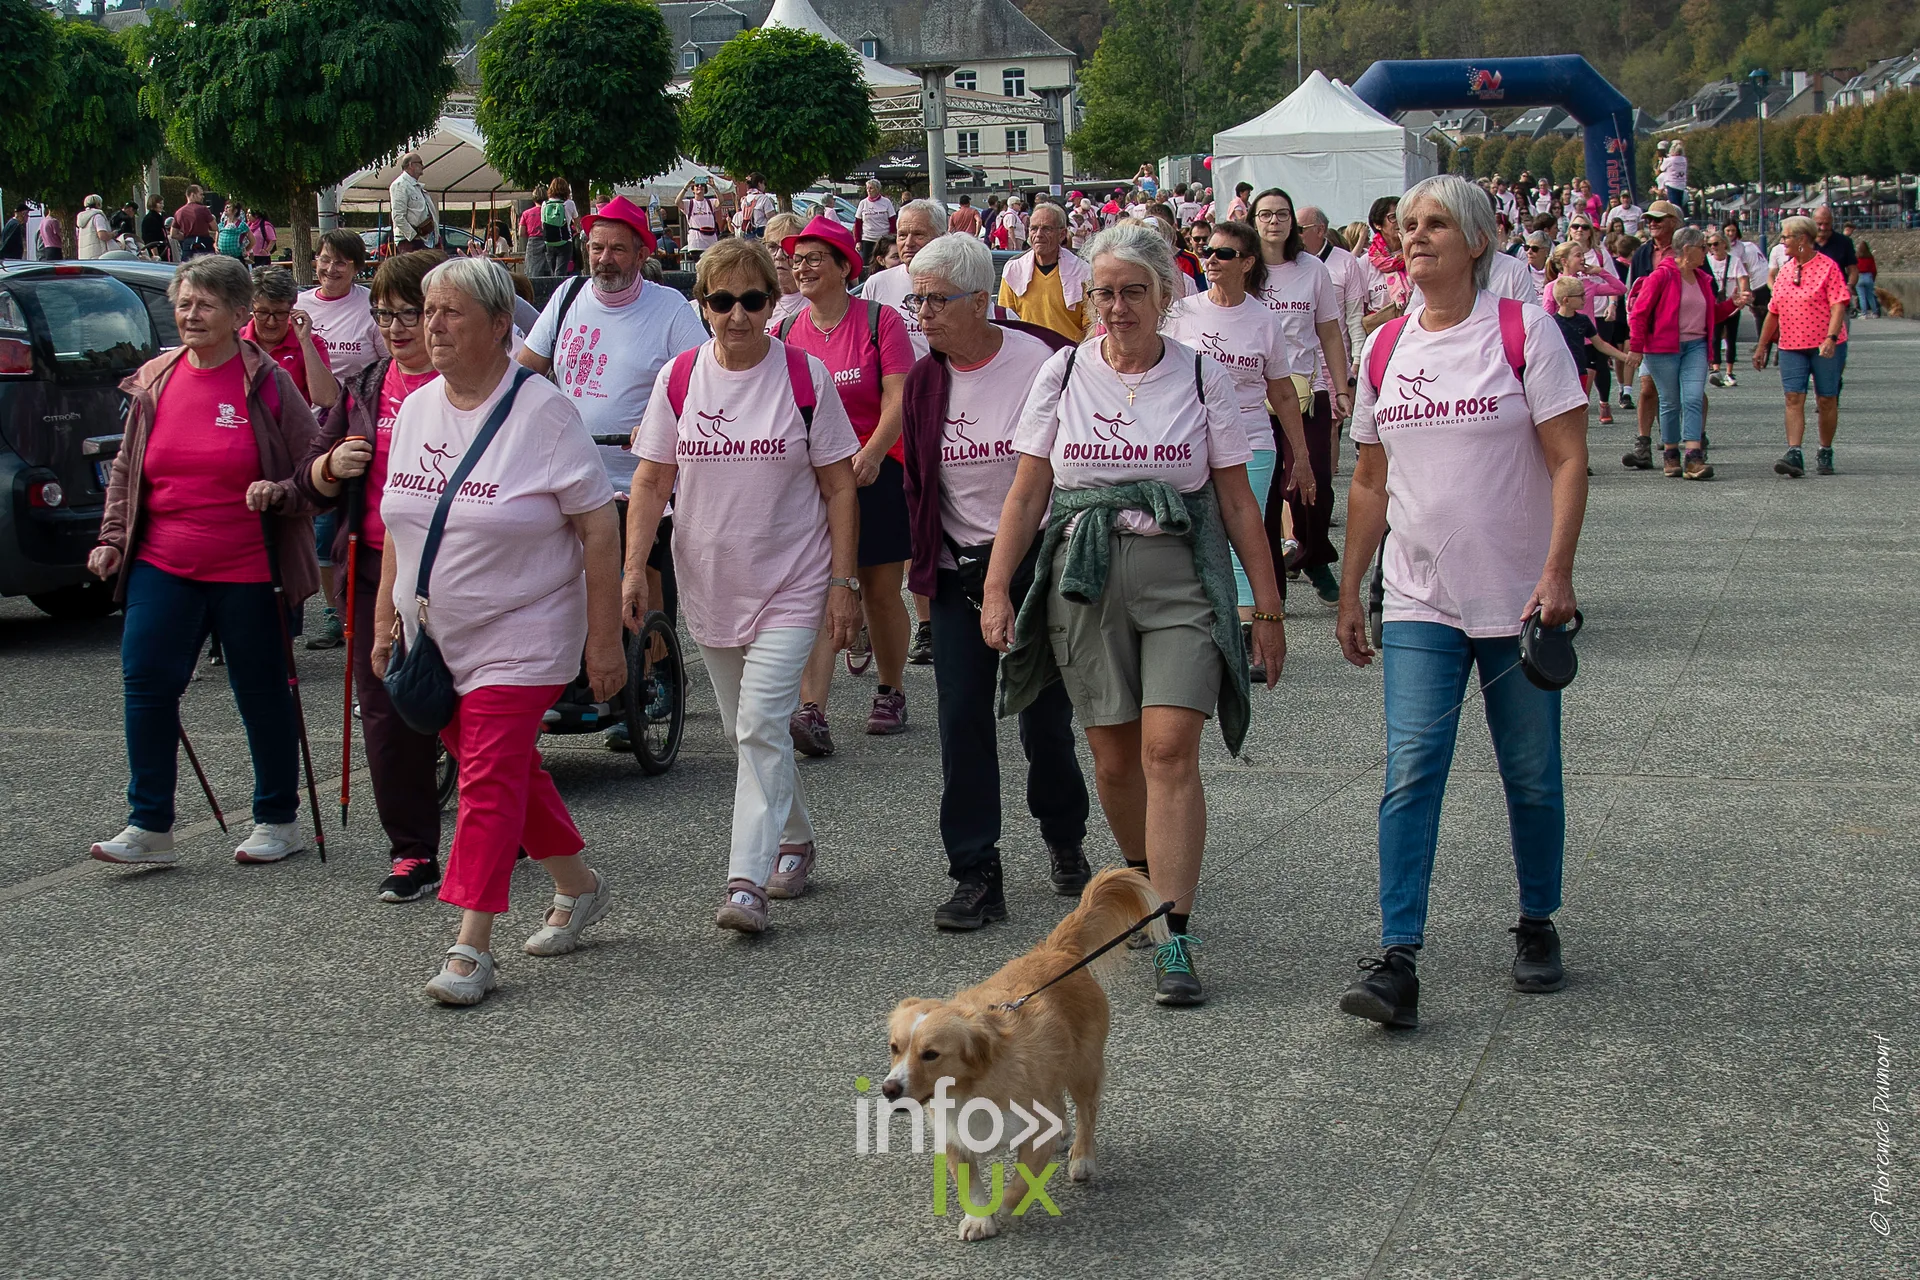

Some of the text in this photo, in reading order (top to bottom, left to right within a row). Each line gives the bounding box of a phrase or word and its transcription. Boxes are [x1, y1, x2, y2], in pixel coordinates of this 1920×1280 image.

[1291, 301, 1311, 311] ROSE
[339, 341, 361, 351] ROSE
[1238, 355, 1259, 369] ROSE
[834, 367, 861, 383] ROSE
[1455, 395, 1499, 417] ROSE
[43, 412, 82, 423] CITROËN
[1396, 422, 1422, 430] CONTRE
[1426, 419, 1434, 427] LE
[1436, 418, 1465, 427] CANCER
[1482, 414, 1500, 422] SEIN
[750, 438, 787, 455] ROSE
[1063, 442, 1192, 462] BOUILLON ROSE
[406, 491, 432, 500] CONTRE
[460, 481, 500, 498] ROSE
